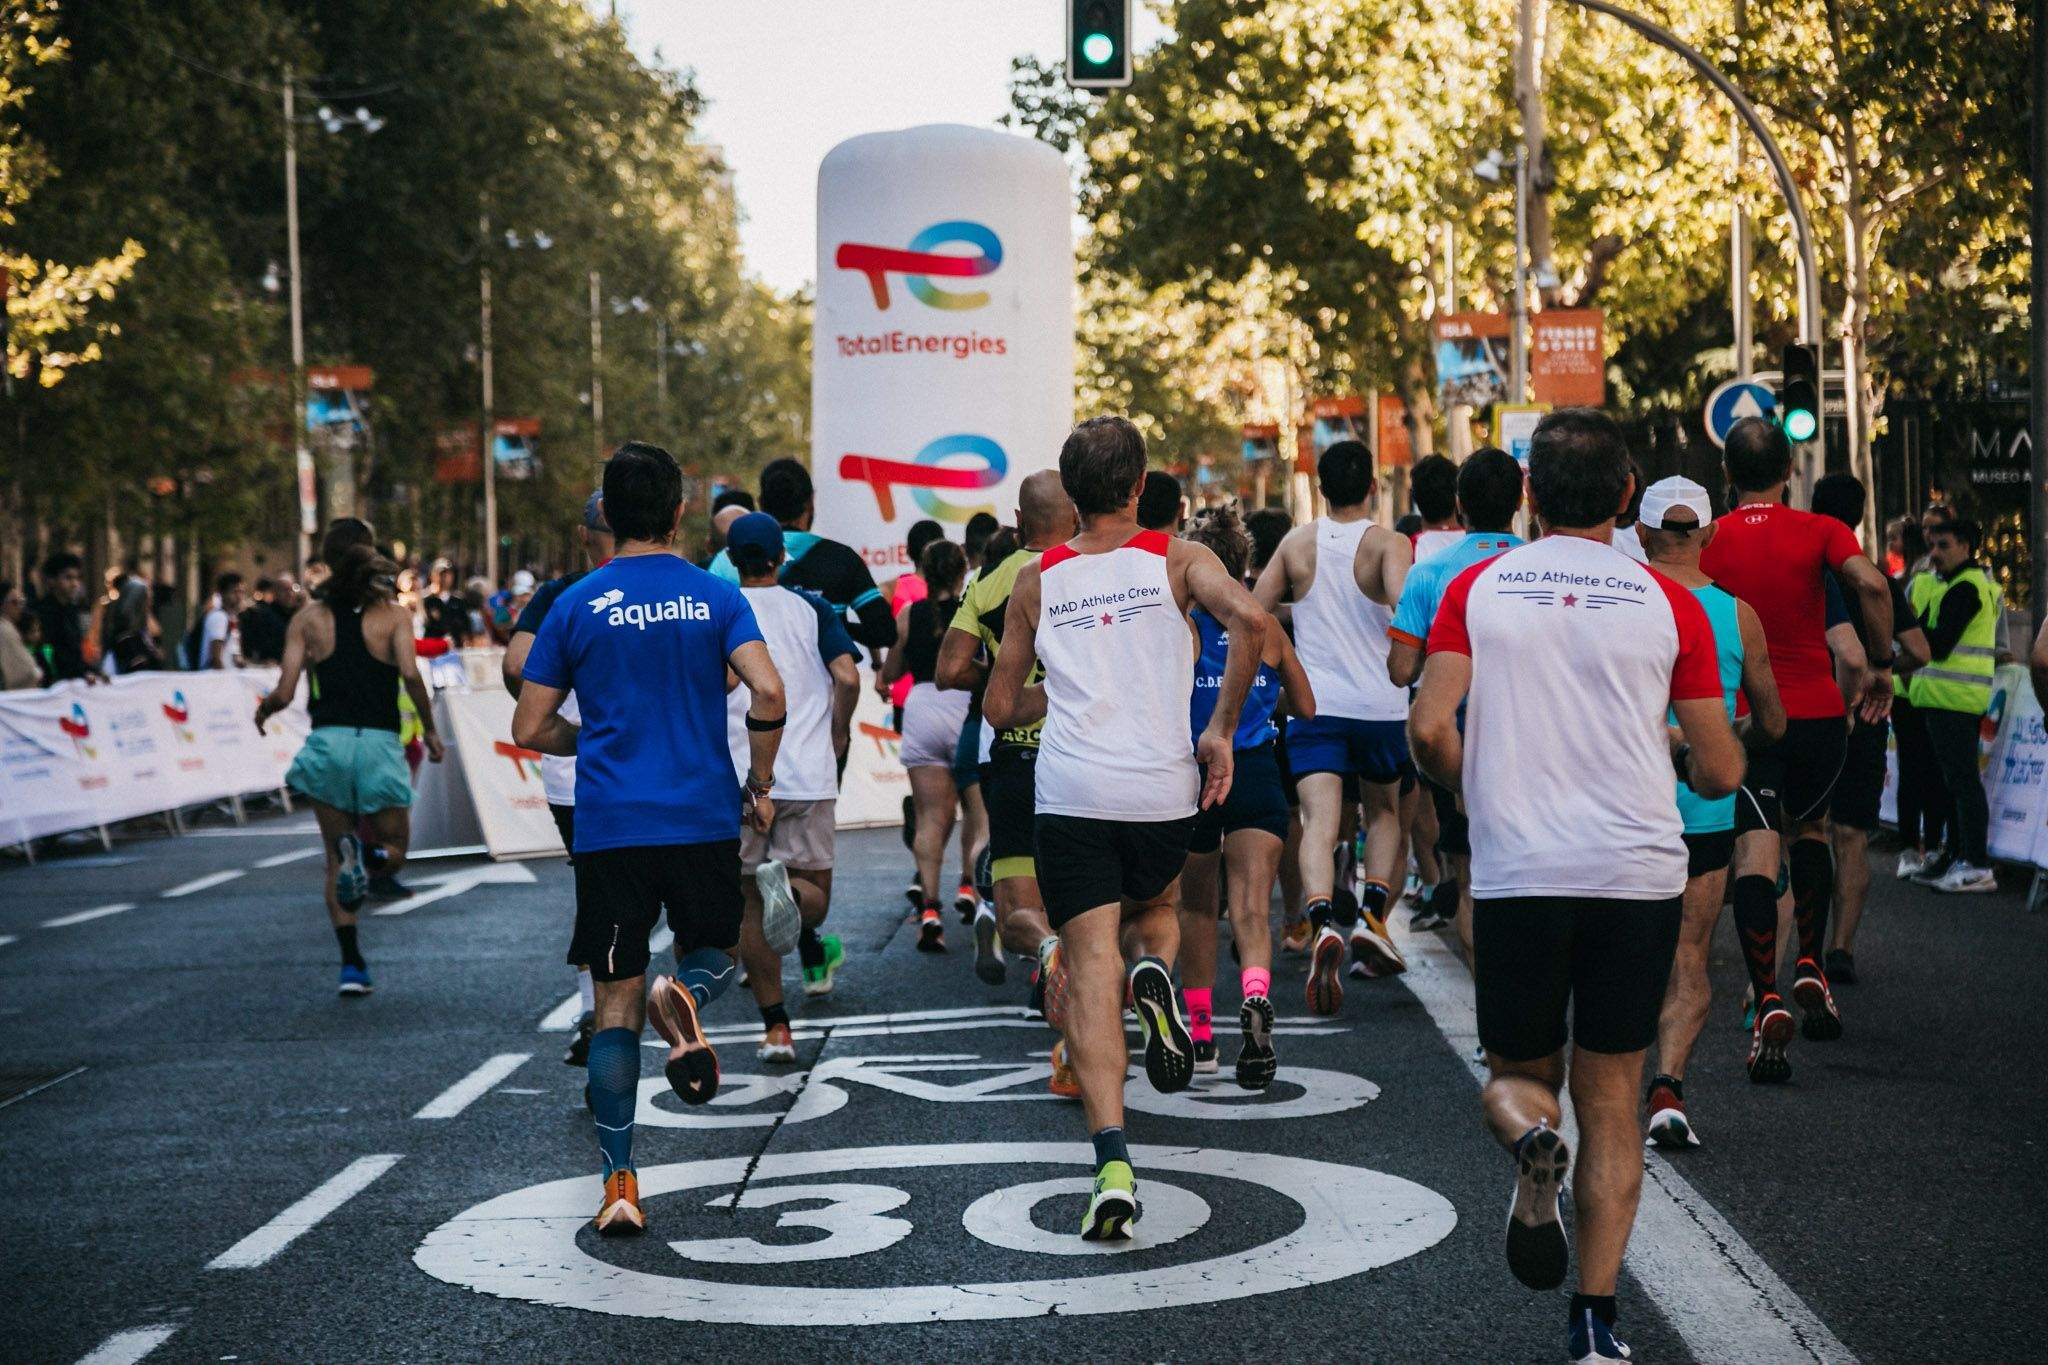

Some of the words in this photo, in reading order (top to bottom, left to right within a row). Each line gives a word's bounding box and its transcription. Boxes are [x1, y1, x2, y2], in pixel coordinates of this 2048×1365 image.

[836, 330, 1007, 359] TotalEnergies
[1972, 470, 2020, 482] MUSEO
[1497, 571, 1537, 583] MAD
[1541, 571, 1600, 587] Athlete
[1605, 577, 1648, 594] Crew
[608, 595, 711, 630] aqualia
[1049, 601, 1078, 618] MAD
[1081, 593, 1125, 610] Athlete
[1128, 587, 1161, 599] Crew
[666, 1177, 1212, 1264] 30
